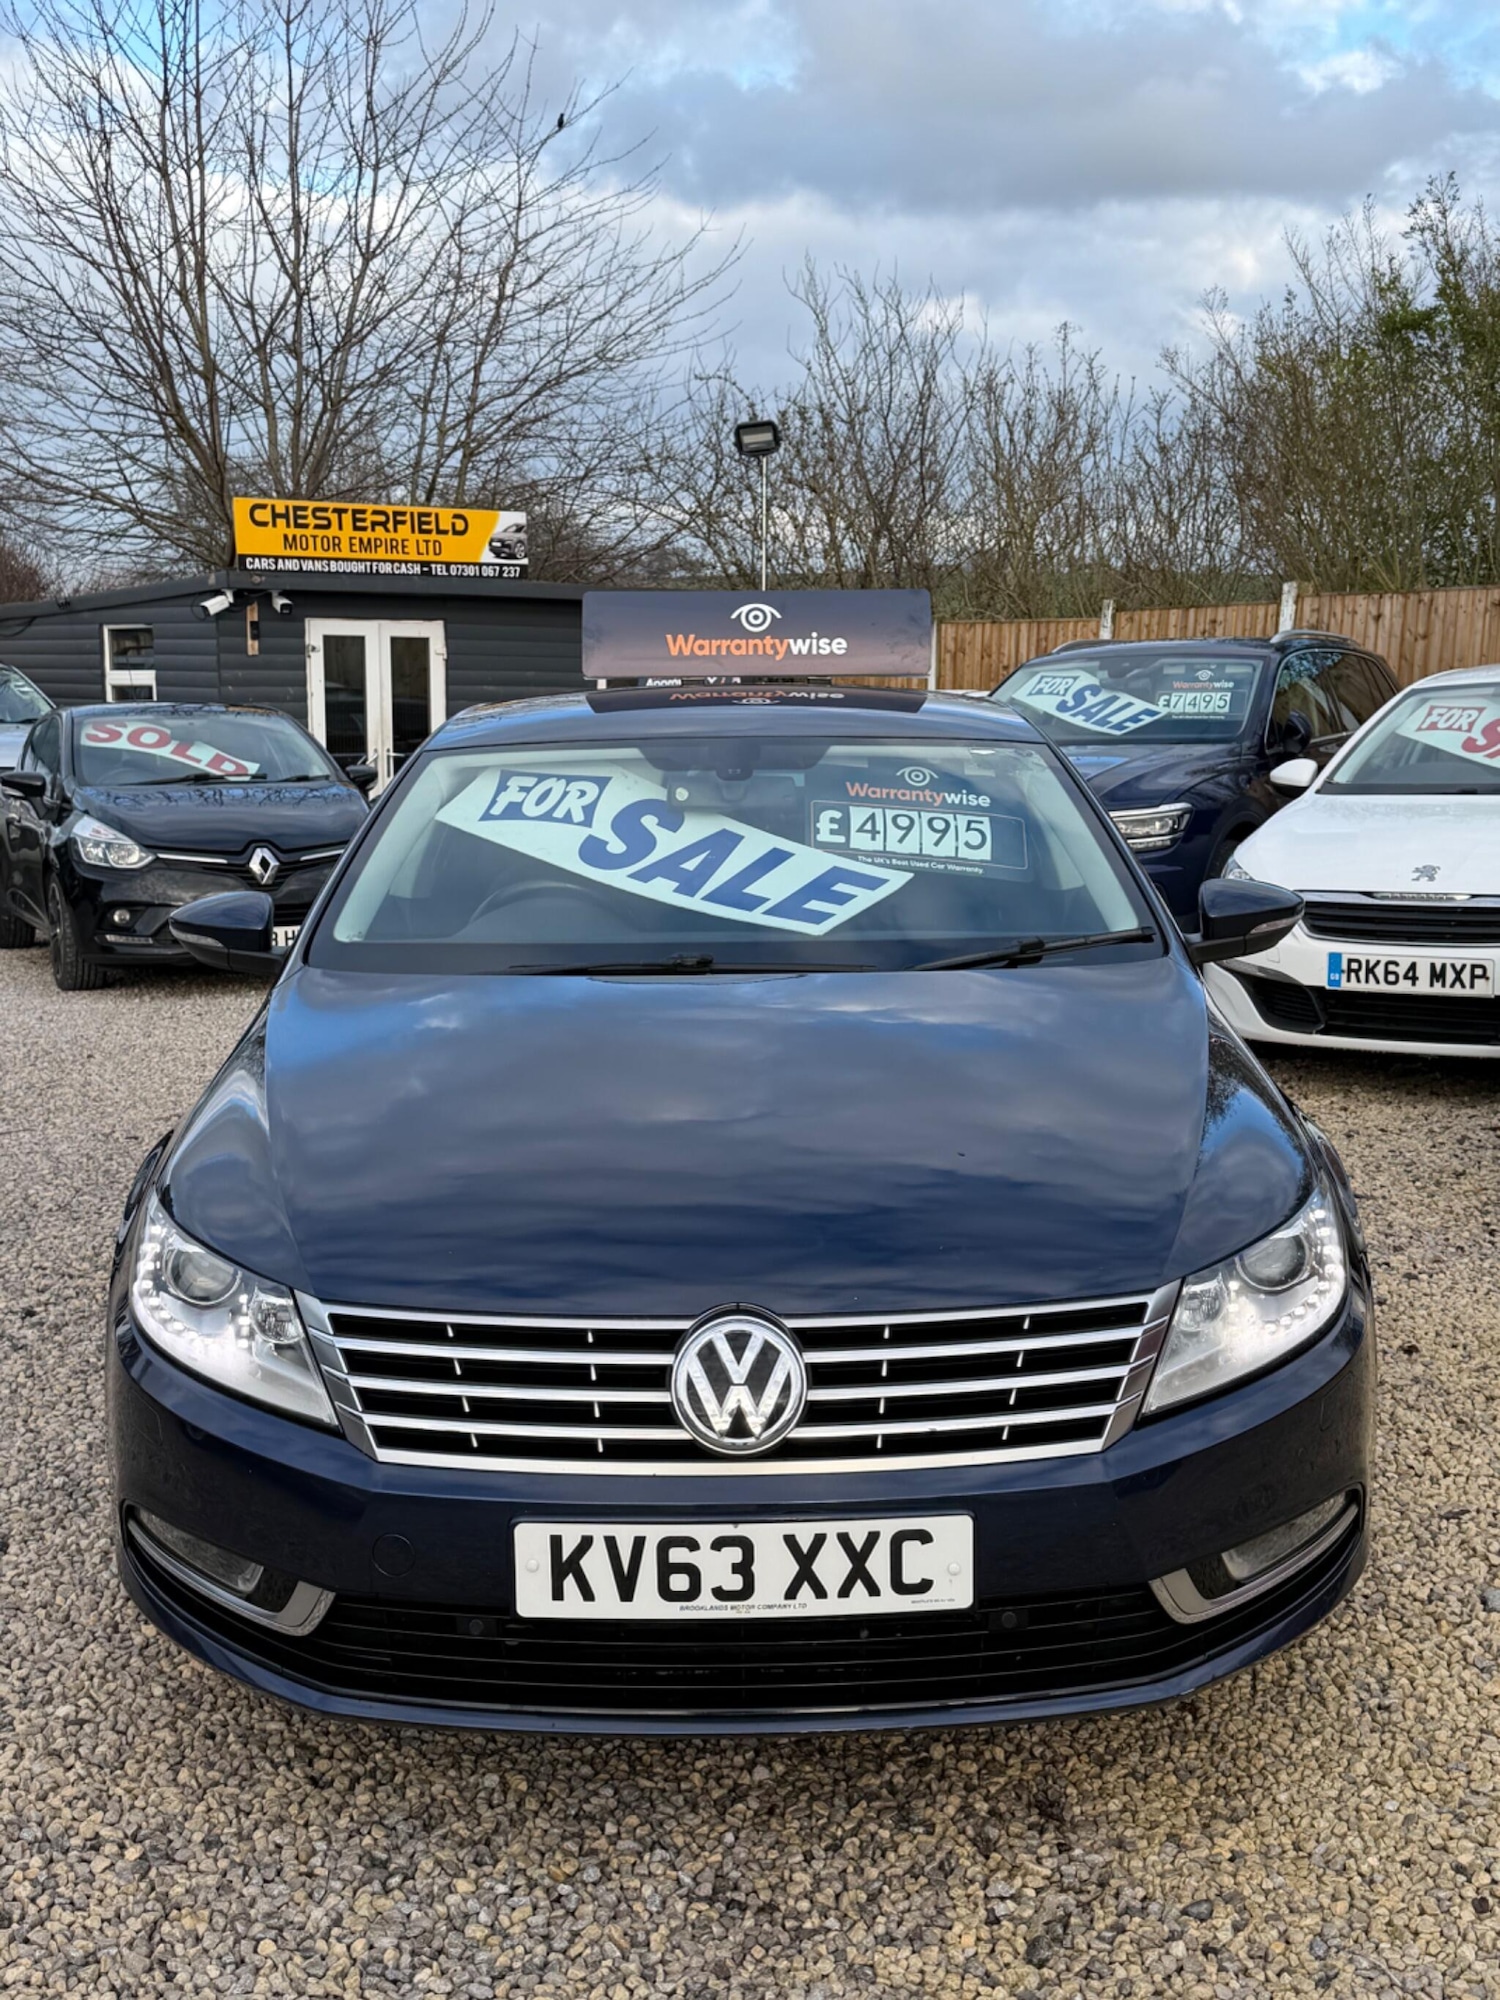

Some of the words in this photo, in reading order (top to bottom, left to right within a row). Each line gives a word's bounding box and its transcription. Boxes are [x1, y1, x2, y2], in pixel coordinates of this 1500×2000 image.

[249, 502, 469, 536] CHESTERFIELD
[283, 534, 342, 553] MOTOR
[348, 536, 410, 555] EMPIRE
[416, 539, 442, 556] LTD
[245, 557, 276, 571] CARS
[277, 559, 300, 571] AND
[300, 559, 332, 572] VANS
[330, 560, 371, 573] BOUGHT
[372, 562, 393, 574] FOR
[393, 563, 421, 575] CASH
[430, 563, 449, 576] TEL
[450, 564, 480, 577] 07301
[481, 565, 500, 577] 067
[502, 566, 520, 578] 237
[665, 631, 848, 661] Warrantywise
[1031, 676, 1075, 696] FOR
[1172, 680, 1235, 690] Warrantywise
[1055, 683, 1163, 732] SALE
[1157, 693, 1229, 710] £7495
[1420, 707, 1480, 731] FOR
[85, 721, 249, 776] SOLD
[488, 774, 601, 824] FOR
[845, 781, 991, 807] Warrantywise
[816, 809, 989, 851] £4995
[578, 798, 891, 926] SALE
[857, 855, 873, 864] The
[873, 856, 891, 865] UK's
[892, 858, 909, 866] Best
[910, 859, 929, 868] Used
[931, 861, 946, 870] Car
[1346, 957, 1419, 987] RK64
[1429, 962, 1488, 990] MXP
[549, 1534, 756, 1603] KV63
[782, 1528, 935, 1601] XXC
[679, 1604, 729, 1612] BROOKLANDS
